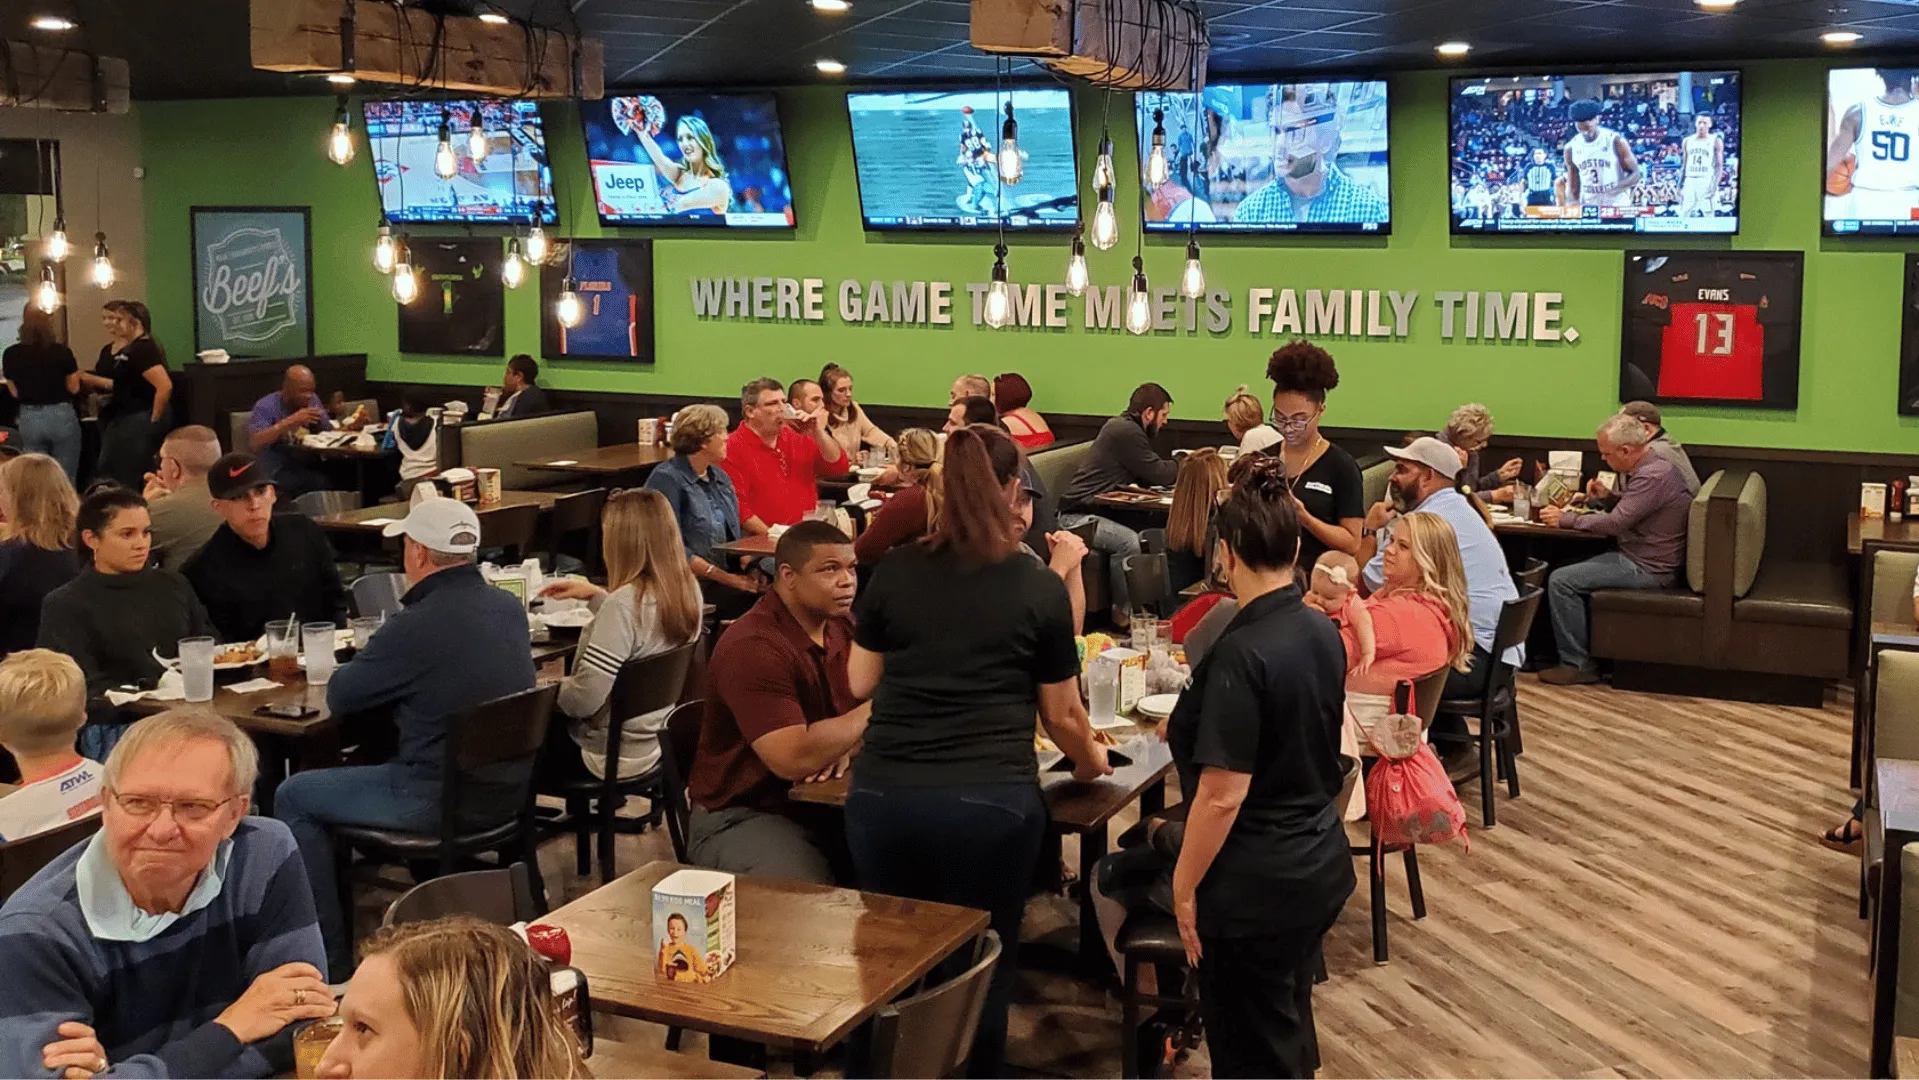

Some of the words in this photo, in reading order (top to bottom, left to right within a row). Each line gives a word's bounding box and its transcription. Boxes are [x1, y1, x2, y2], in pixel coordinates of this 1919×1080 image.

[1871, 130, 1910, 161] 50
[1692, 154, 1703, 166] 14
[605, 174, 644, 192] Jeep
[1589, 169, 1599, 184] 3
[203, 254, 300, 319] Beef's
[1698, 288, 1730, 301] EVANS
[592, 294, 601, 315] 1
[690, 277, 824, 320] WHERE
[838, 279, 951, 324] GAME
[966, 283, 1067, 327] TME
[1085, 285, 1231, 333] METS
[1248, 288, 1420, 337] FAMILY
[1434, 290, 1580, 343] TIME.
[1695, 312, 1735, 356] 13
